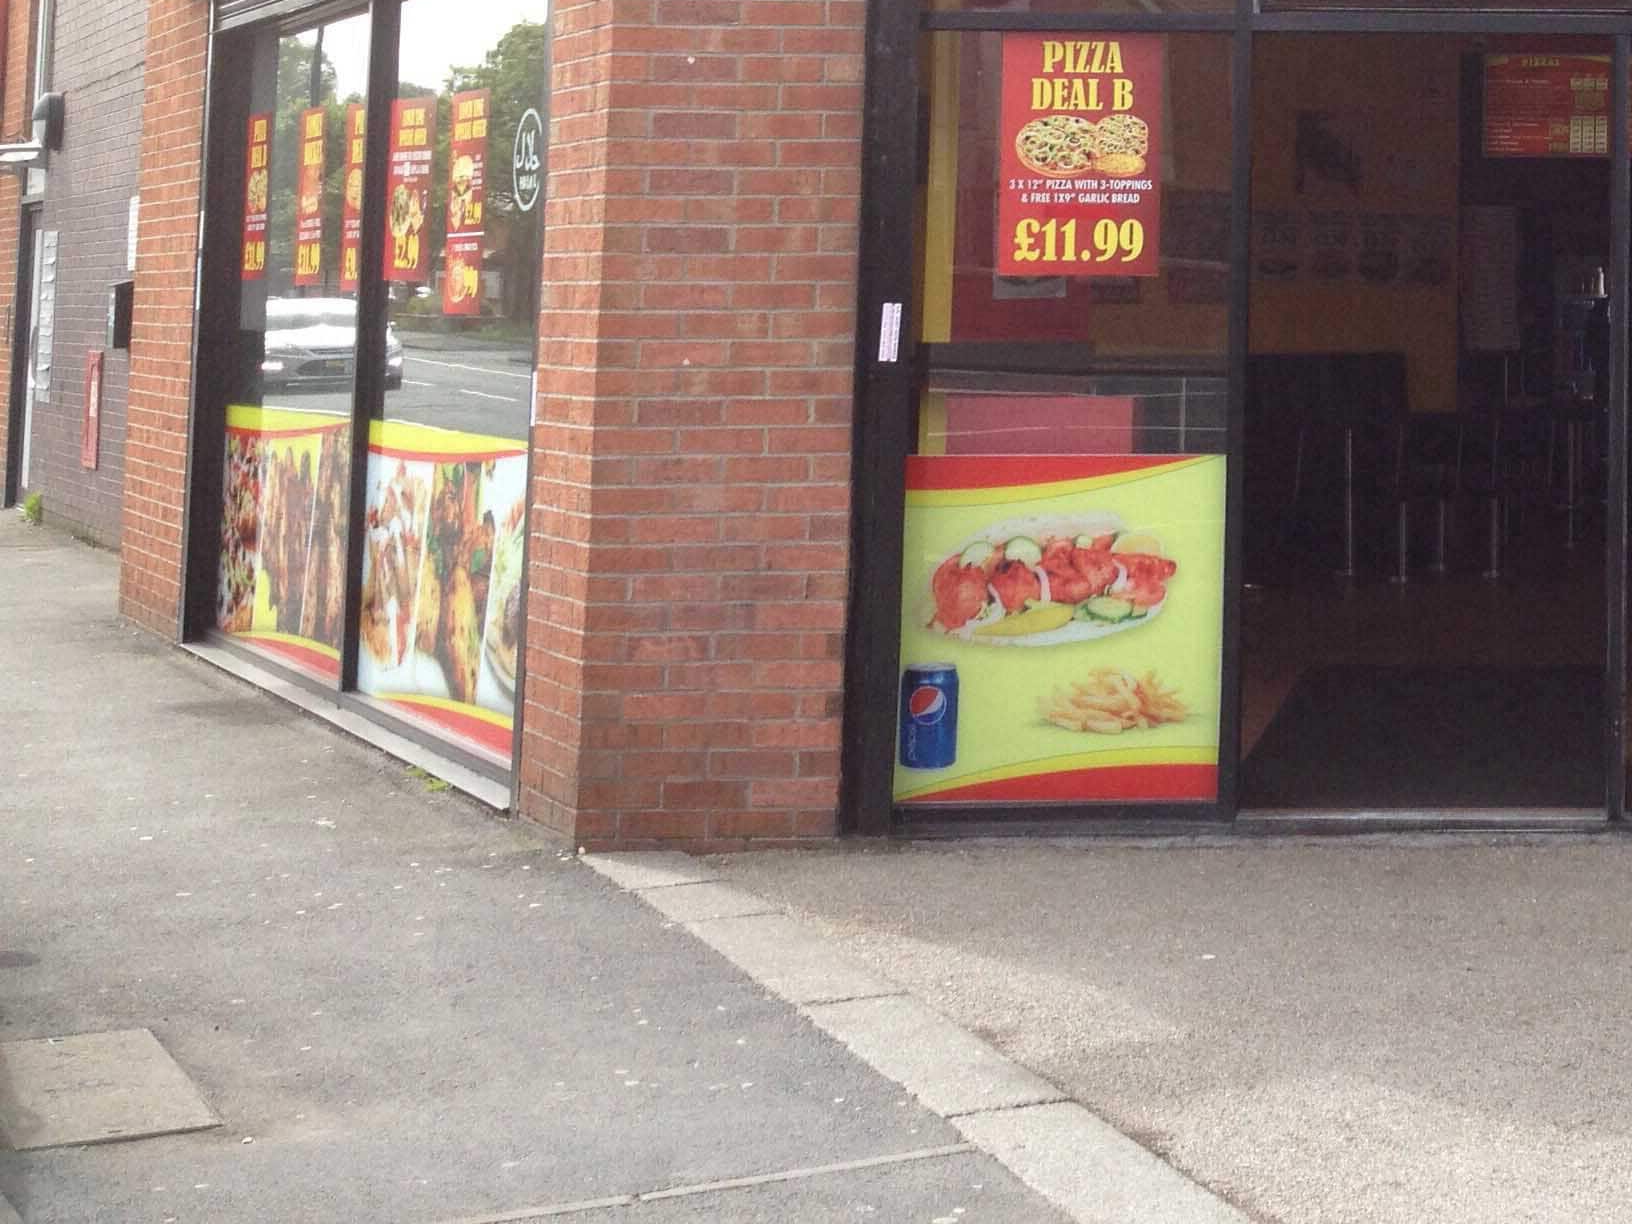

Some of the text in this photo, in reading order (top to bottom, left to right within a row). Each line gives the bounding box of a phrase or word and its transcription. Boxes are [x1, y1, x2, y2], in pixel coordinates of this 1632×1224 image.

[1042, 41, 1124, 73] PIZZA
[1031, 78, 1134, 110] DEAL B
[1030, 192, 1051, 203] FREE
[1078, 193, 1110, 204] GARLIC
[1112, 193, 1140, 204] BREAD
[1046, 179, 1073, 190] PIZZA
[1074, 179, 1098, 190] WITH
[1100, 180, 1153, 191] 3-TOPPINGS
[1013, 218, 1145, 263] £11.99
